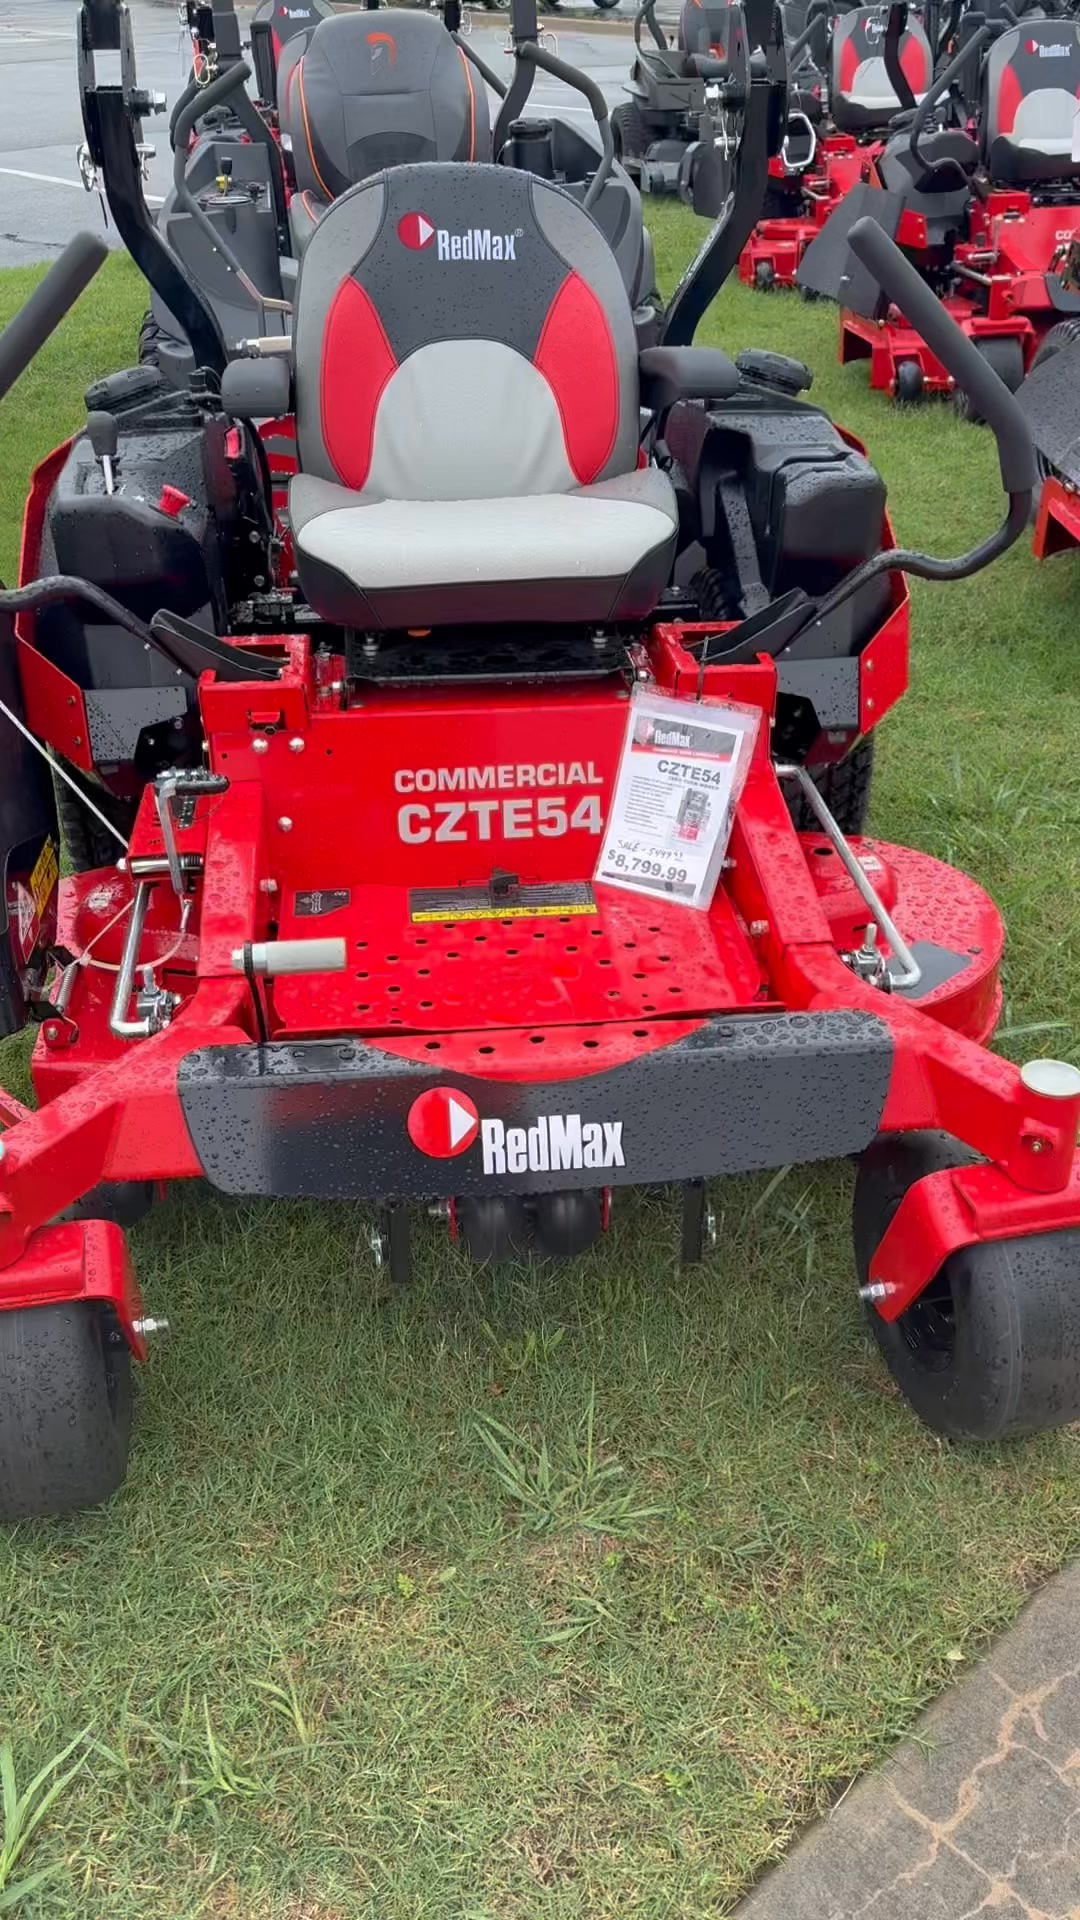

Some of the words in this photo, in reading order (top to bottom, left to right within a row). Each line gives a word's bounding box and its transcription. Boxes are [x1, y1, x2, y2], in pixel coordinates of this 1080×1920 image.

[654, 730, 690, 748] RedMax
[394, 761, 604, 793] COMMERCIAL
[657, 760, 721, 785] CZTE54
[397, 795, 604, 844] CZTE54
[617, 839, 640, 852] SALE
[607, 848, 688, 882] $8,799.99
[481, 1114, 626, 1175] RedMax
